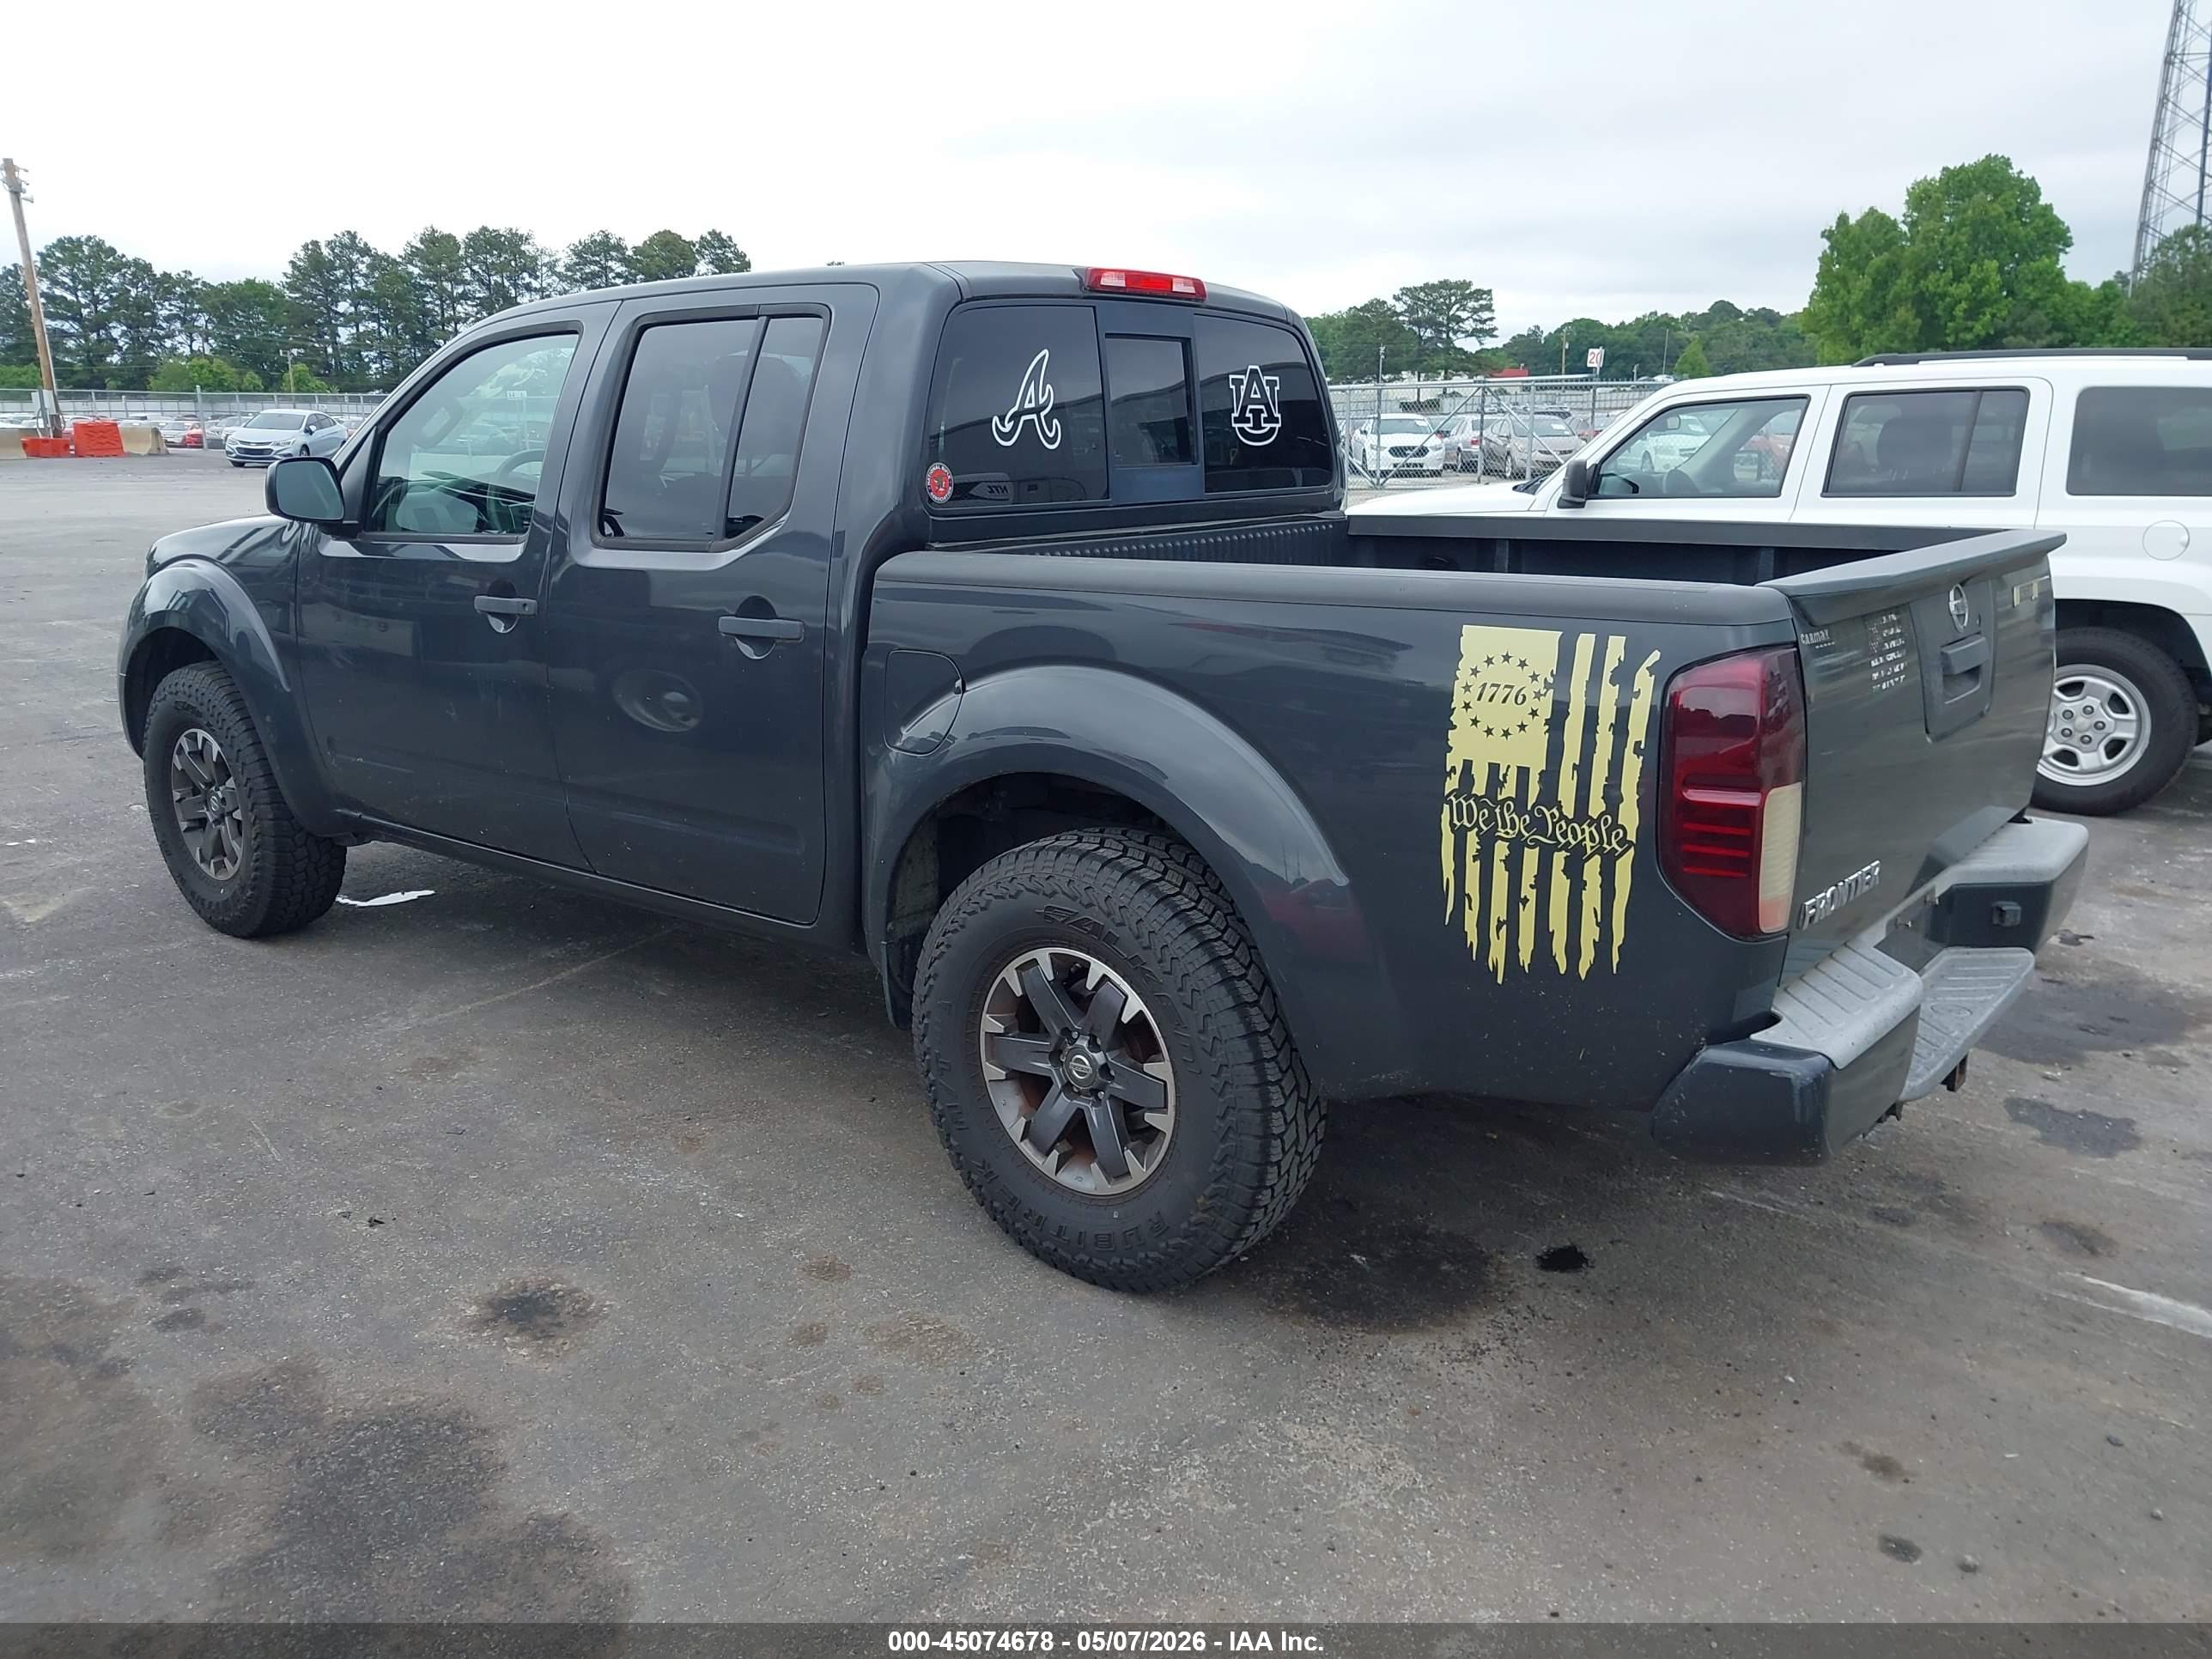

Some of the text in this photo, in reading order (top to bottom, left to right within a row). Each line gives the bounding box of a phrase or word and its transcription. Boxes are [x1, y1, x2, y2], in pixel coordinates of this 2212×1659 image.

[992, 349, 1061, 449] A
[1475, 683, 1527, 706] 1776
[1447, 794, 1629, 860] We the People
[1798, 860, 1881, 930] FRONTIER
